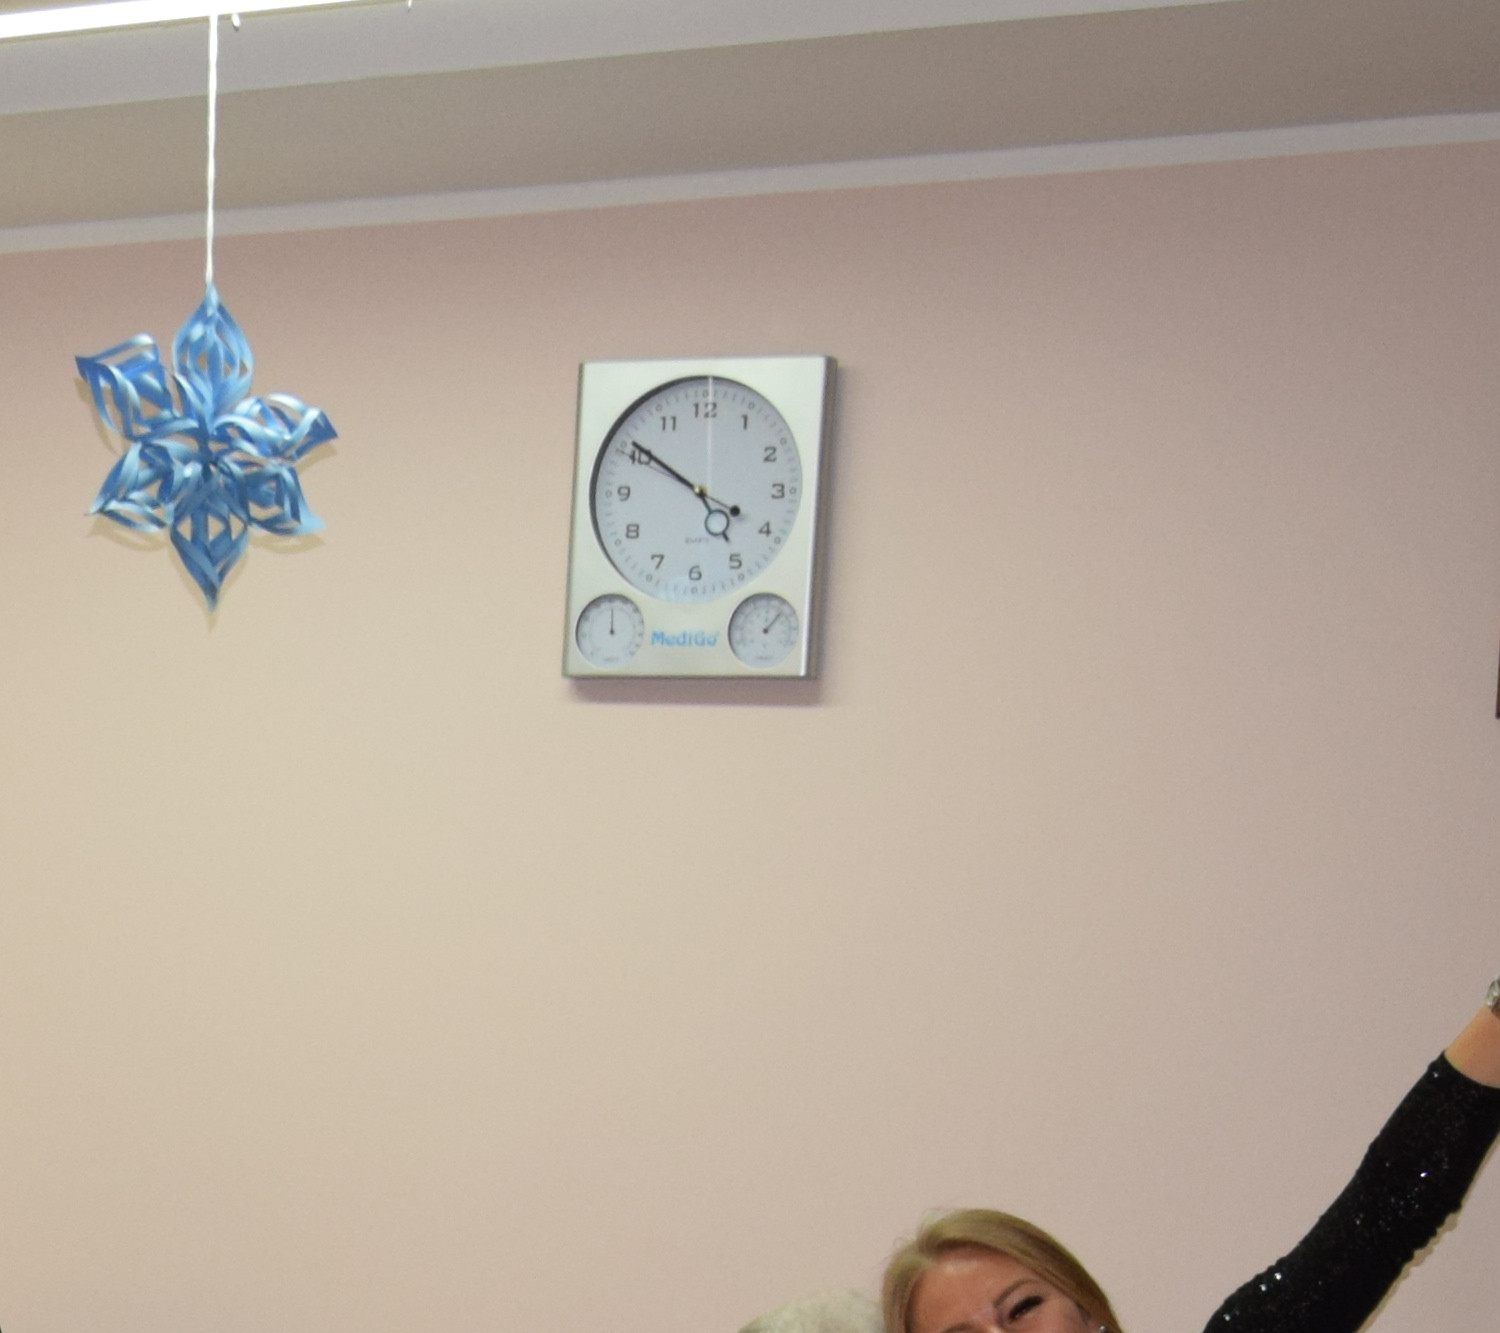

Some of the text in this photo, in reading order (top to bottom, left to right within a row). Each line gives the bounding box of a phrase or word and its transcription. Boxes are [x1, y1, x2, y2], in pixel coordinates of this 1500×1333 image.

[692, 402, 718, 419] 12
[660, 415, 677, 432] 11
[740, 414, 749, 430] 1
[763, 446, 777, 463] 2
[617, 486, 631, 502] 9
[771, 483, 786, 500] 3
[625, 523, 640, 539] 8
[758, 521, 772, 538] 4
[651, 554, 665, 570] 7
[729, 553, 743, 570] 5
[688, 565, 702, 581] 6
